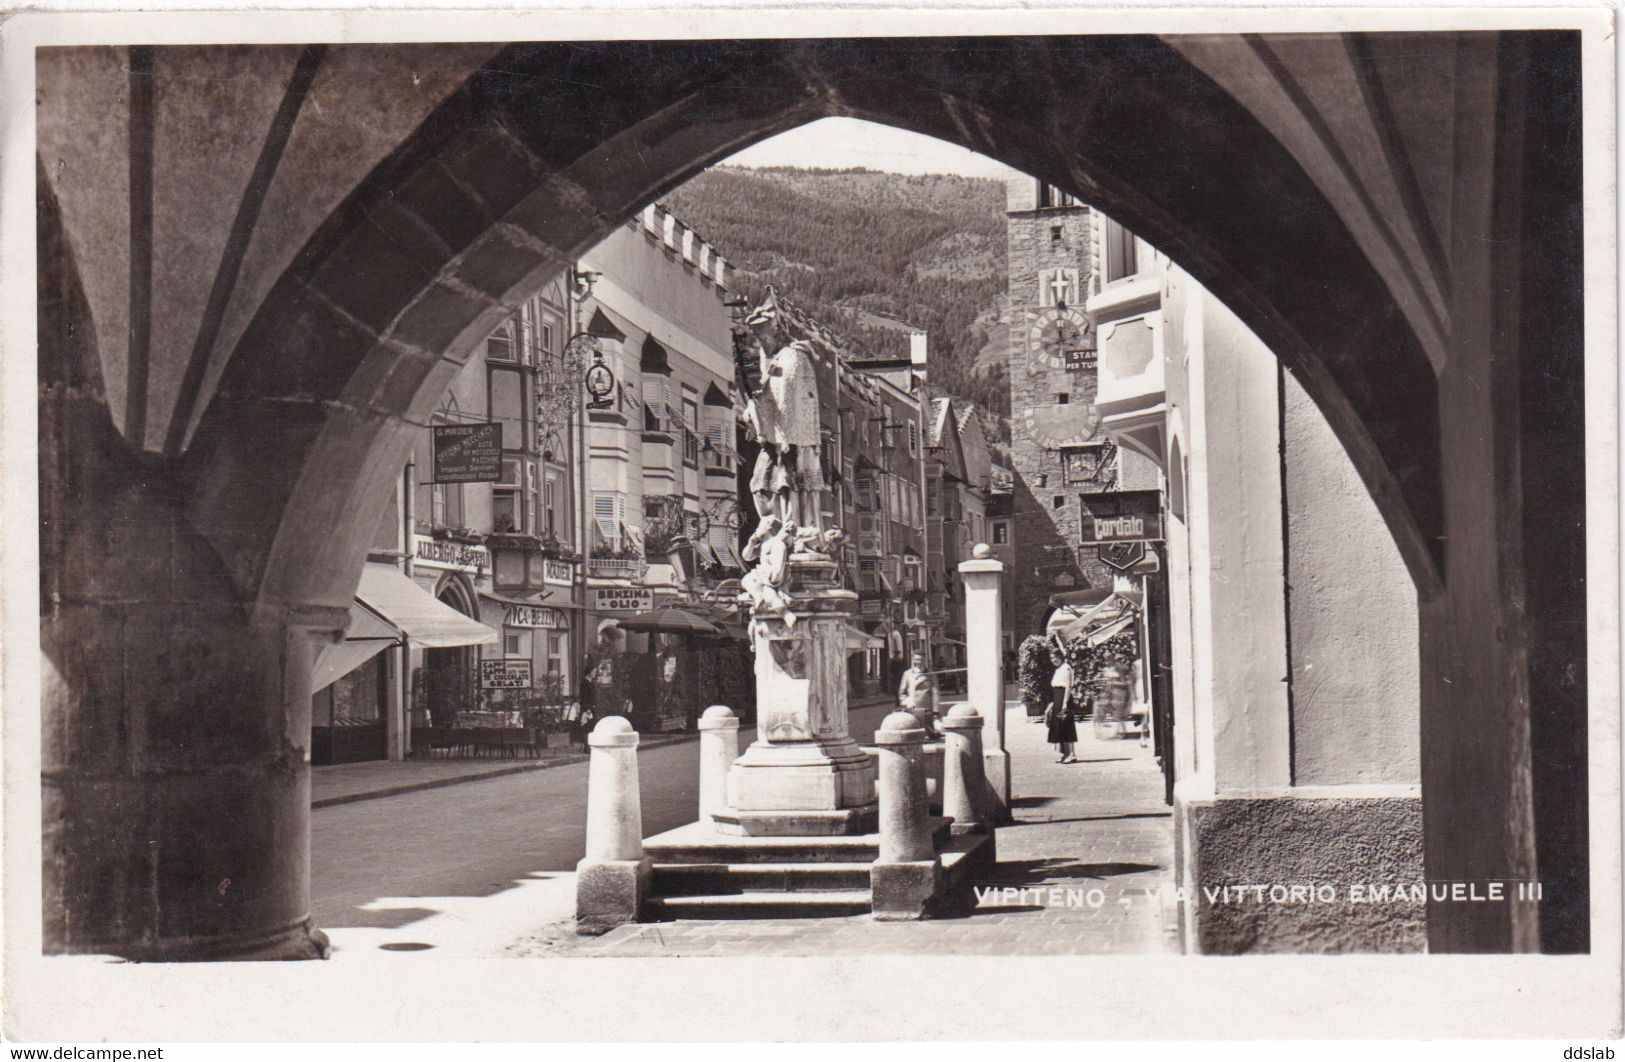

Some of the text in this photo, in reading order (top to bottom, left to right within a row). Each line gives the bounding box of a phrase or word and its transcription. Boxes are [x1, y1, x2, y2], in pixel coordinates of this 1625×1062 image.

[1072, 351, 1097, 360] STAN
[416, 540, 456, 565] ALBERGO
[598, 590, 650, 599] BENZINA
[610, 600, 639, 608] OLIO
